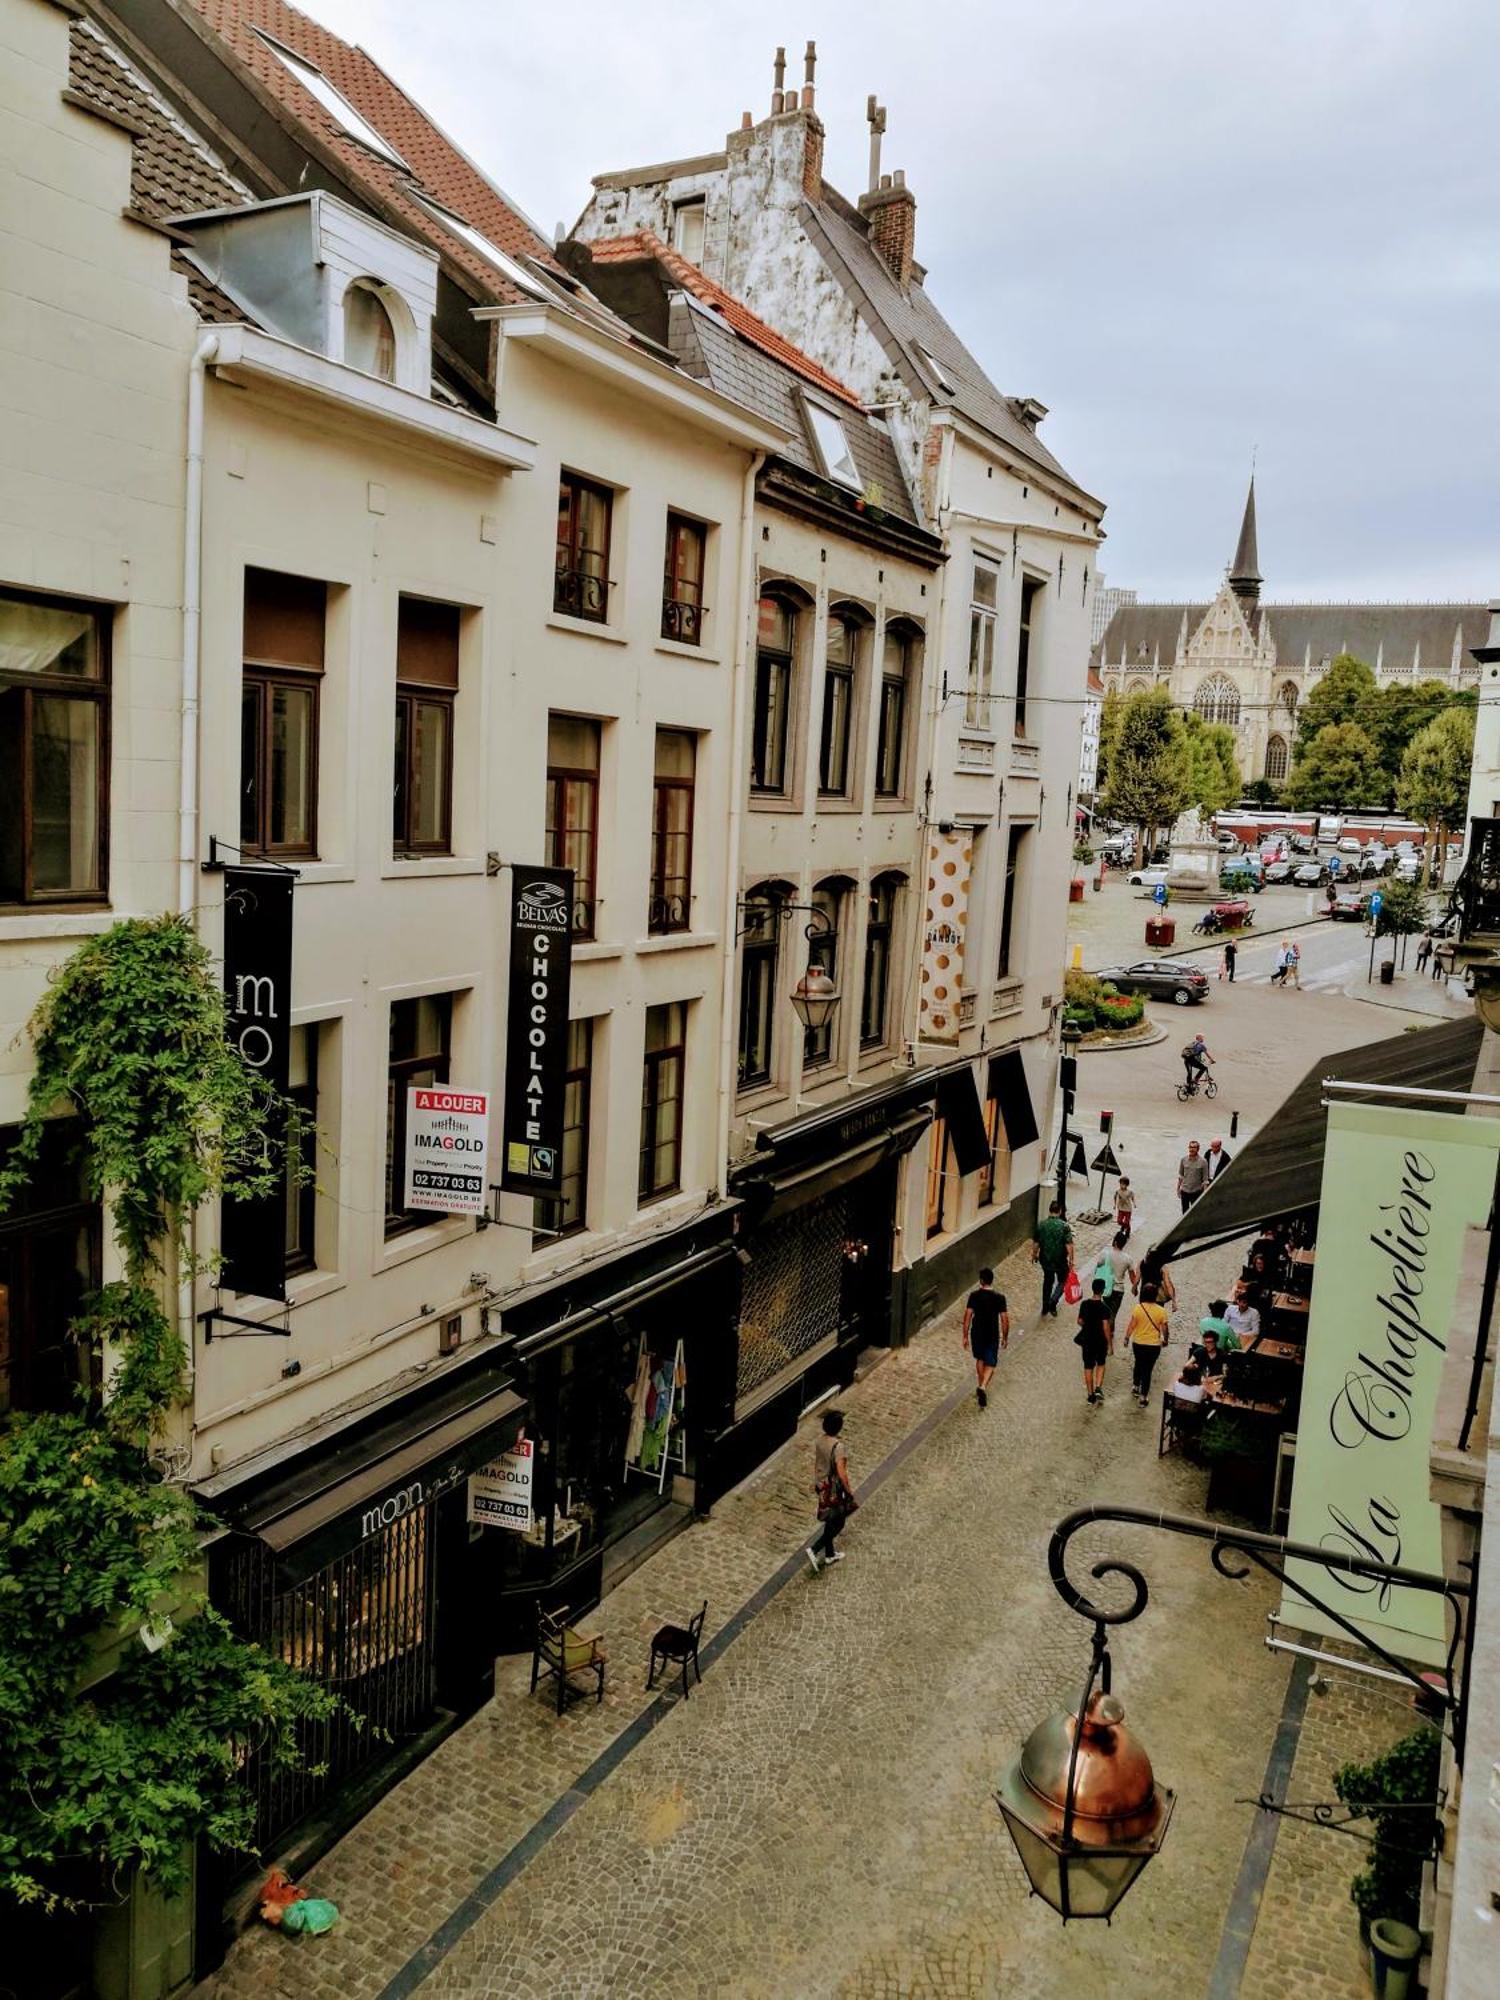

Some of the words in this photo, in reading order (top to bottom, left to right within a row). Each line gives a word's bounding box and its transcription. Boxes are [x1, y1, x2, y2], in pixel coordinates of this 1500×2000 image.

[1331, 860, 1338, 869] P
[1155, 886, 1164, 897] P
[1372, 895, 1381, 906] P
[517, 901, 567, 924] BELVAS
[526, 934, 550, 1141] CHOCOLATE
[419, 1094, 430, 1108] A
[434, 1096, 483, 1112] LOUER
[415, 1134, 484, 1152] IMAGOLD
[415, 1174, 429, 1186] 02
[430, 1175, 450, 1187] 737
[451, 1177, 465, 1189] 03
[467, 1179, 480, 1191] 63
[1330, 1151, 1447, 1449] Chapelière
[362, 1482, 423, 1538] moon
[487, 1502, 503, 1510] 737
